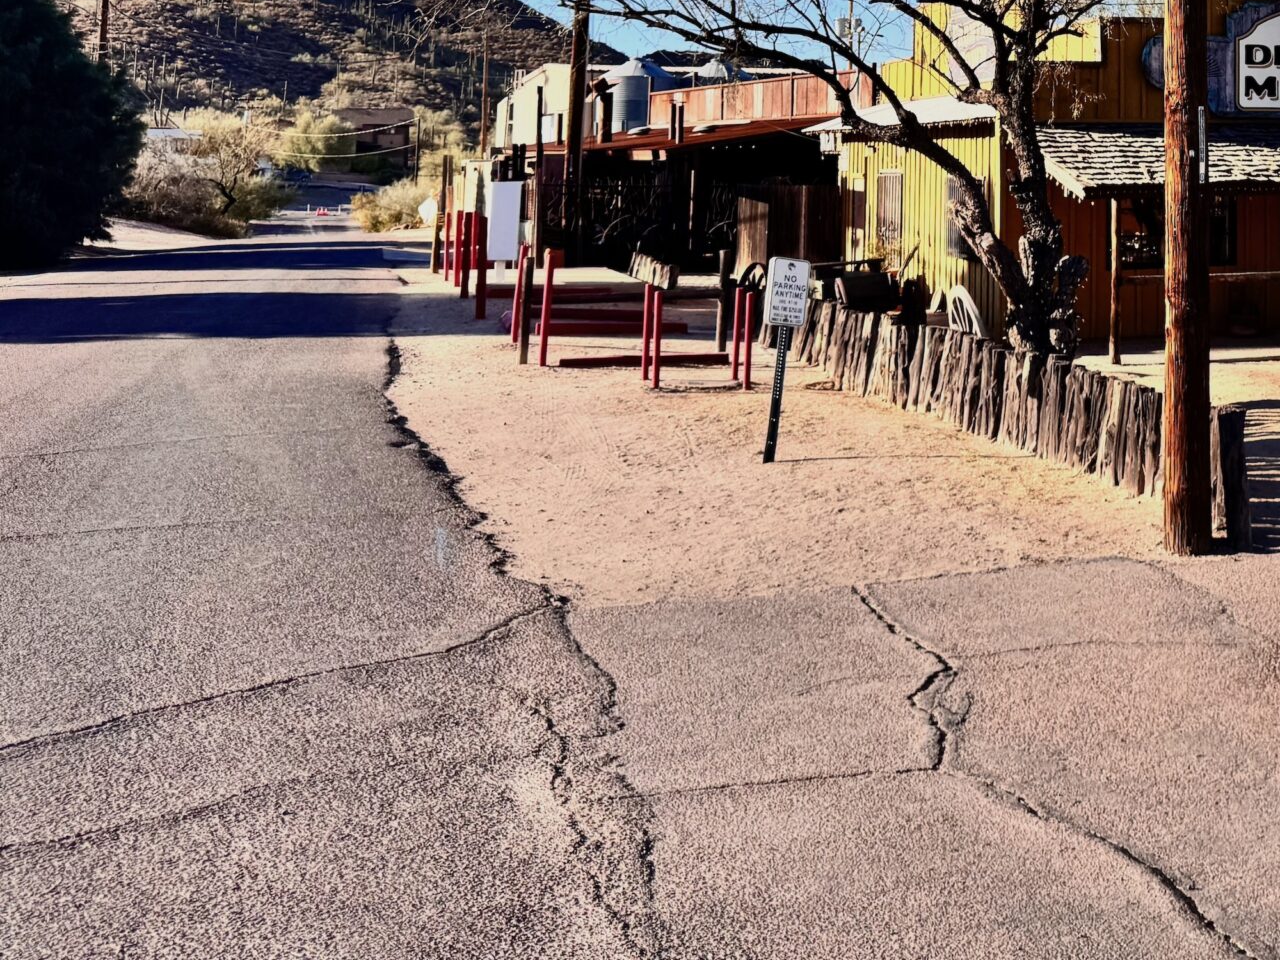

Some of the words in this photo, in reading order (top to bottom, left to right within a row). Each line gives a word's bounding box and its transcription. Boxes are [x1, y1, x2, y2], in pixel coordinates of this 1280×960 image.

[784, 274, 798, 283] NO
[774, 281, 806, 292] PARKING
[775, 290, 804, 300] ANYTIME
